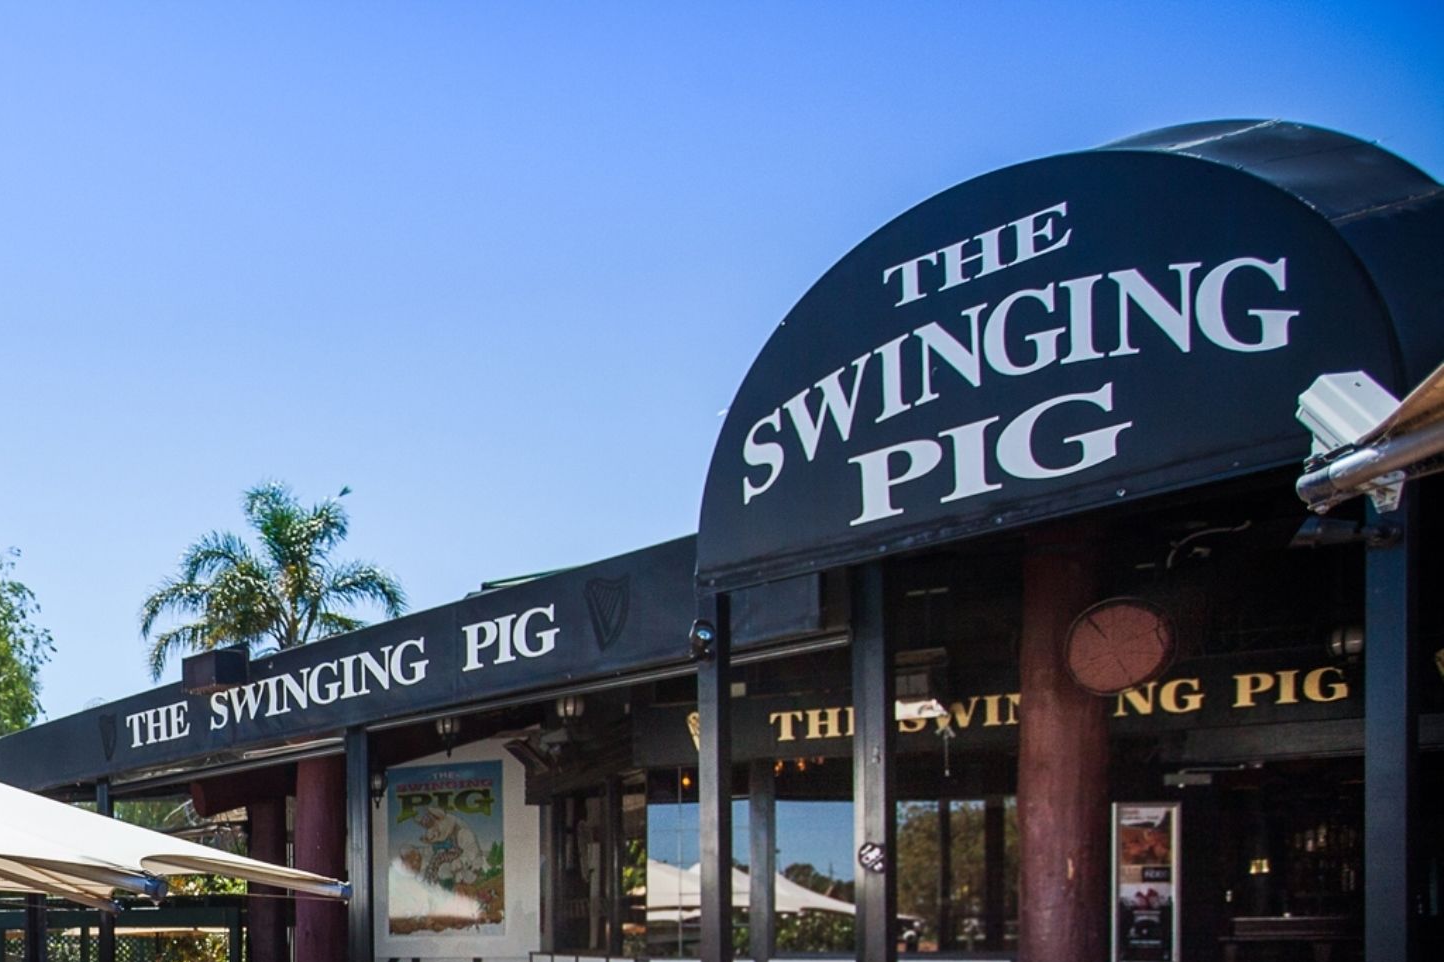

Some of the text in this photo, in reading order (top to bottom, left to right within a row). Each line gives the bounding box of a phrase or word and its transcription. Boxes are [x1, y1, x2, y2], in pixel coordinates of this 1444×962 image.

[883, 201, 1073, 307] THE
[741, 256, 1300, 504] SWINGING
[848, 382, 1133, 526] PIG
[125, 603, 560, 749] THE SWINGING PIG
[769, 706, 854, 742] TH
[1231, 667, 1350, 708] PIG
[396, 779, 493, 792] SWINGING
[397, 789, 494, 823] PIG
[432, 771, 456, 779] THE
